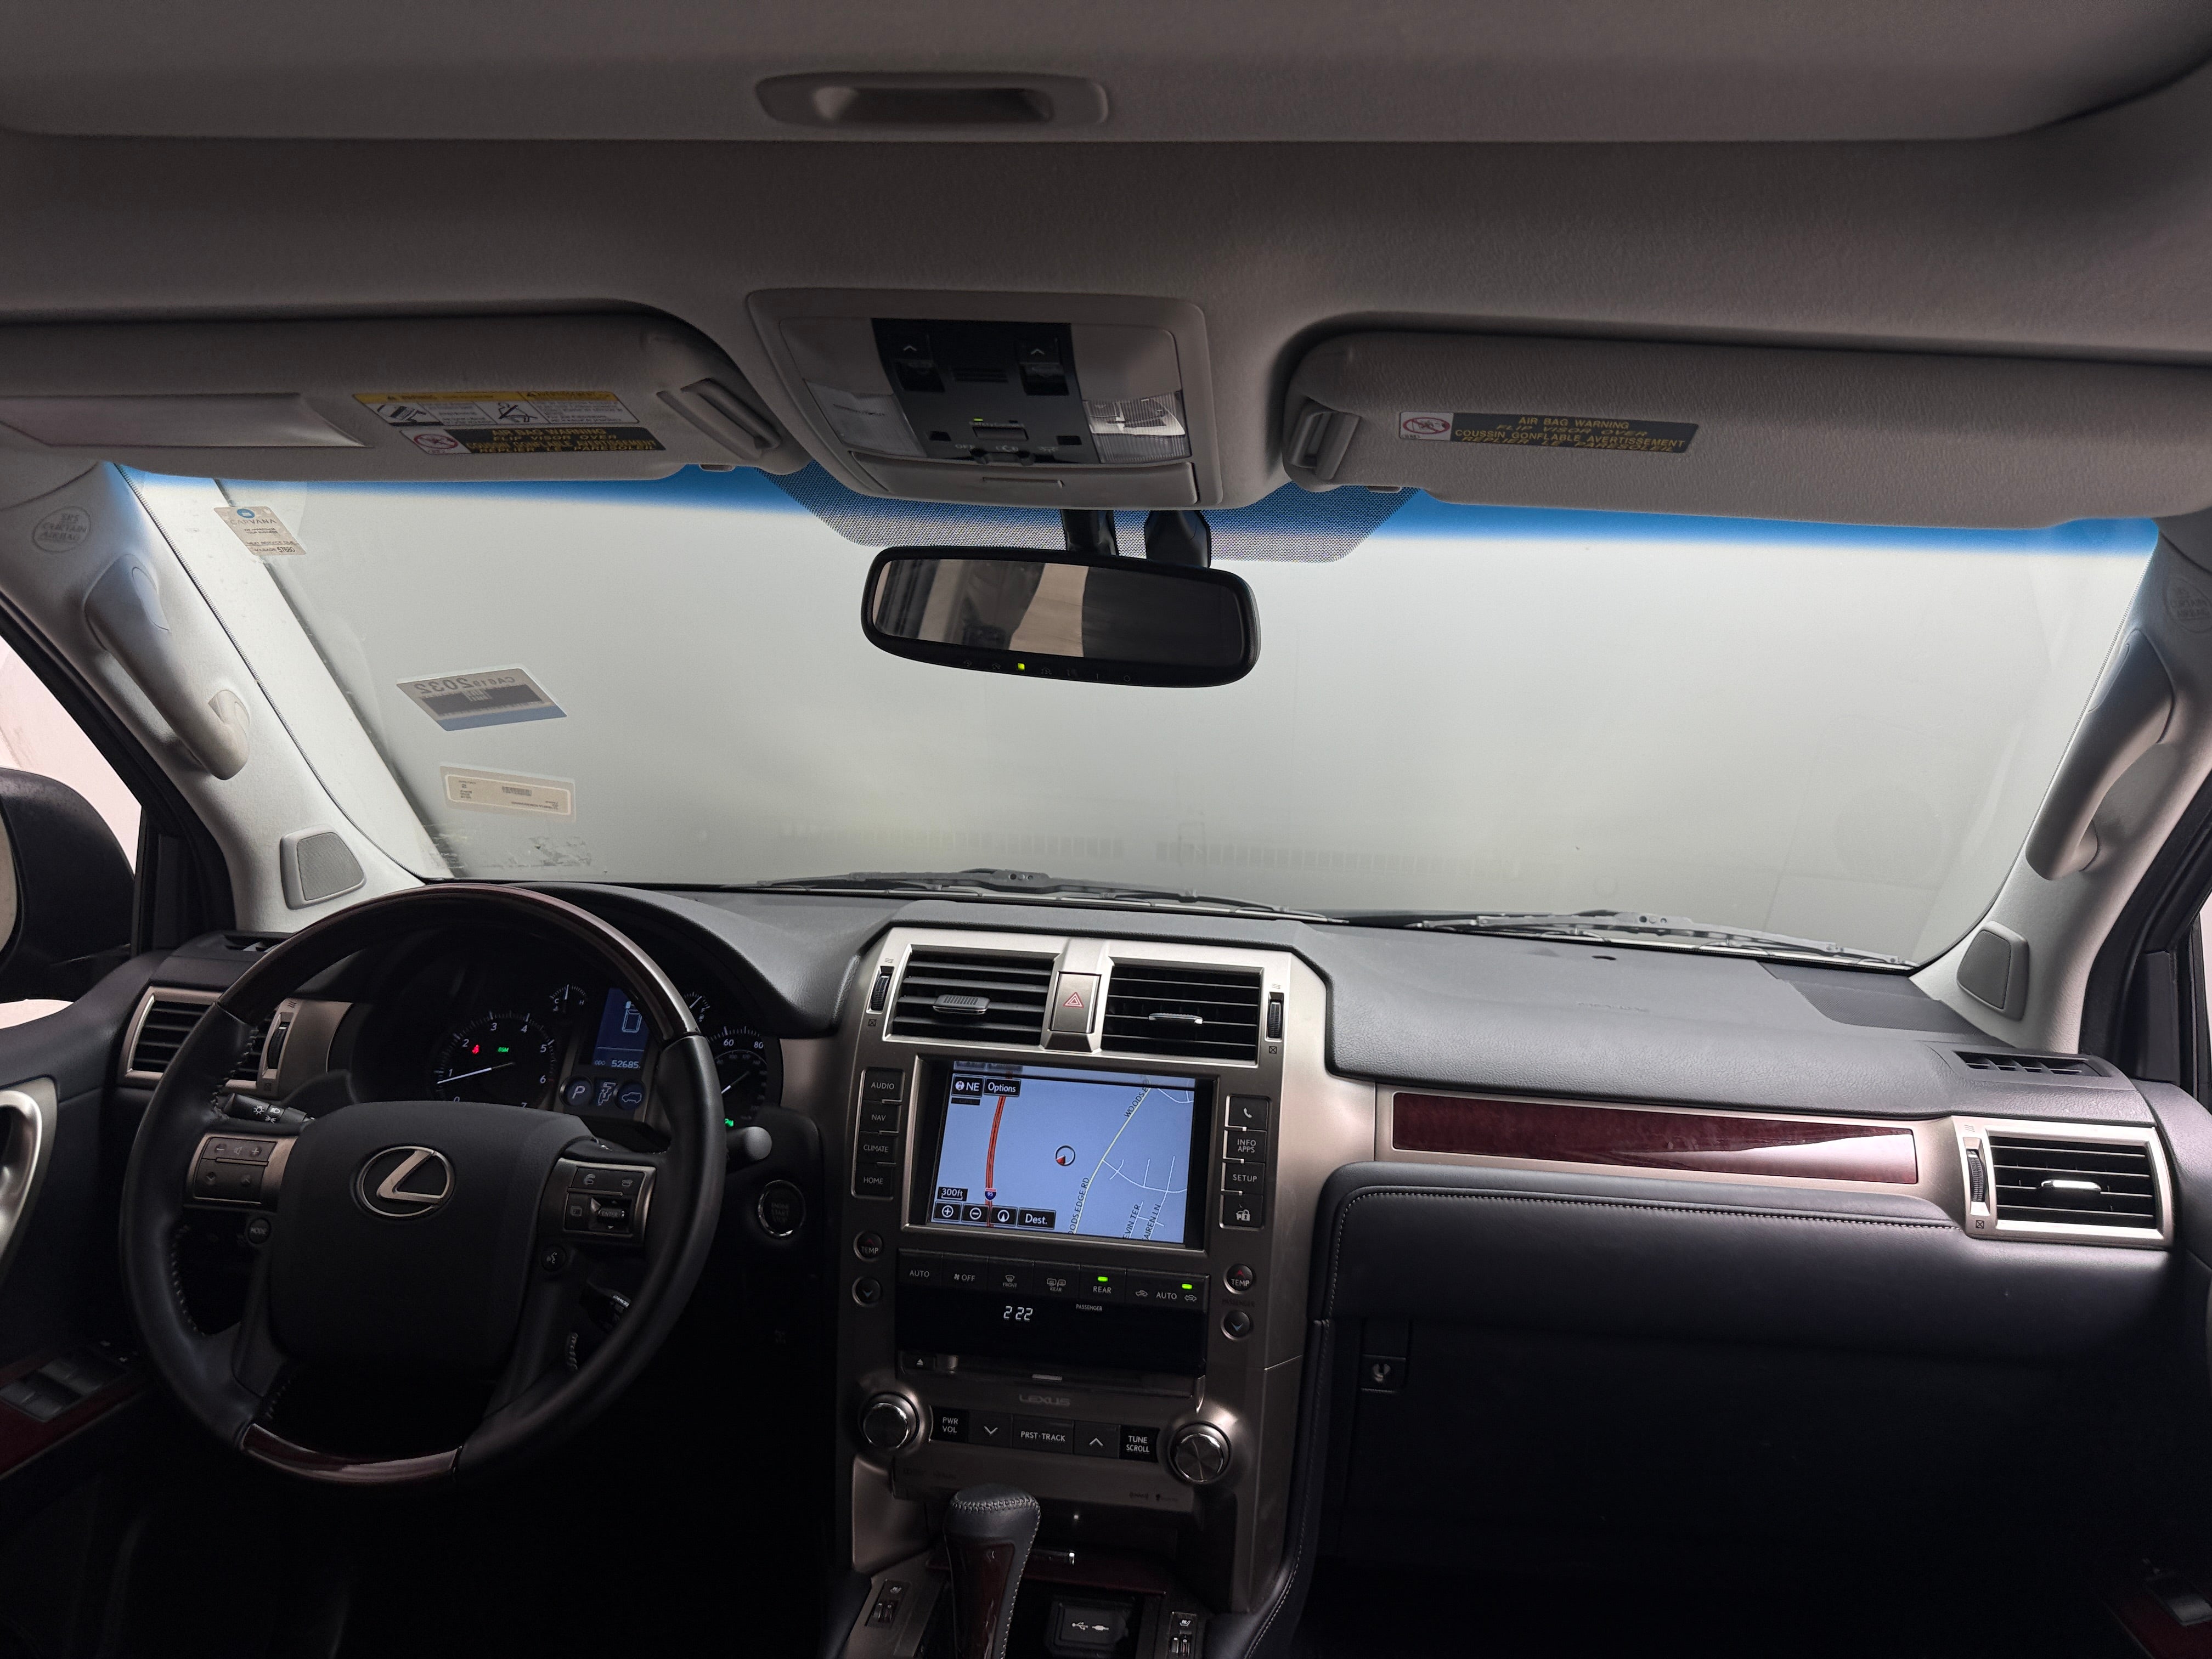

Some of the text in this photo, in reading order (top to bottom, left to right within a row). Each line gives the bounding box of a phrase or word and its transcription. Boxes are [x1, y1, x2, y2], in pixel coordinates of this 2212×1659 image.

[1519, 416, 1629, 430] AIR BAG WARNING
[1455, 430, 1686, 448] COUSSIN GONFLABLE AVERTISSEMENT
[490, 1022, 498, 1031] 3
[521, 1024, 528, 1034] 4
[461, 1039, 470, 1048] 2
[723, 1039, 765, 1049] 60 80
[540, 1044, 548, 1053] 5
[539, 1075, 548, 1084] 6
[871, 1081, 895, 1090] AUDIO
[966, 1081, 980, 1092] NE
[988, 1081, 1017, 1093] Options
[572, 1085, 586, 1099] P
[1124, 1092, 1146, 1118] WOODS
[863, 1144, 889, 1153] CLIMATE
[863, 1176, 884, 1185] HOME
[1232, 1173, 1258, 1183] SETUP
[942, 1188, 964, 1197] 300ft
[1074, 1189, 1086, 1215] EDGE
[1081, 1177, 1090, 1189] RD
[1130, 1203, 1141, 1219] TER
[1024, 1212, 1048, 1225] Dest.
[1143, 1203, 1161, 1241] AIREN LN
[861, 1246, 879, 1254] TEMP
[909, 1269, 930, 1278] AUTO
[961, 1273, 976, 1282] OFF
[1231, 1278, 1251, 1287] TEMP
[1092, 1285, 1113, 1294] REAR
[1155, 1291, 1177, 1300] AUTO
[1075, 1304, 1103, 1312] PASSENGER
[1018, 1394, 1071, 1407] LEXUS
[942, 1417, 959, 1425] PWR
[941, 1426, 957, 1434] VOL
[1128, 1435, 1148, 1444] TUNE
[1125, 1444, 1150, 1453] SCROLL
